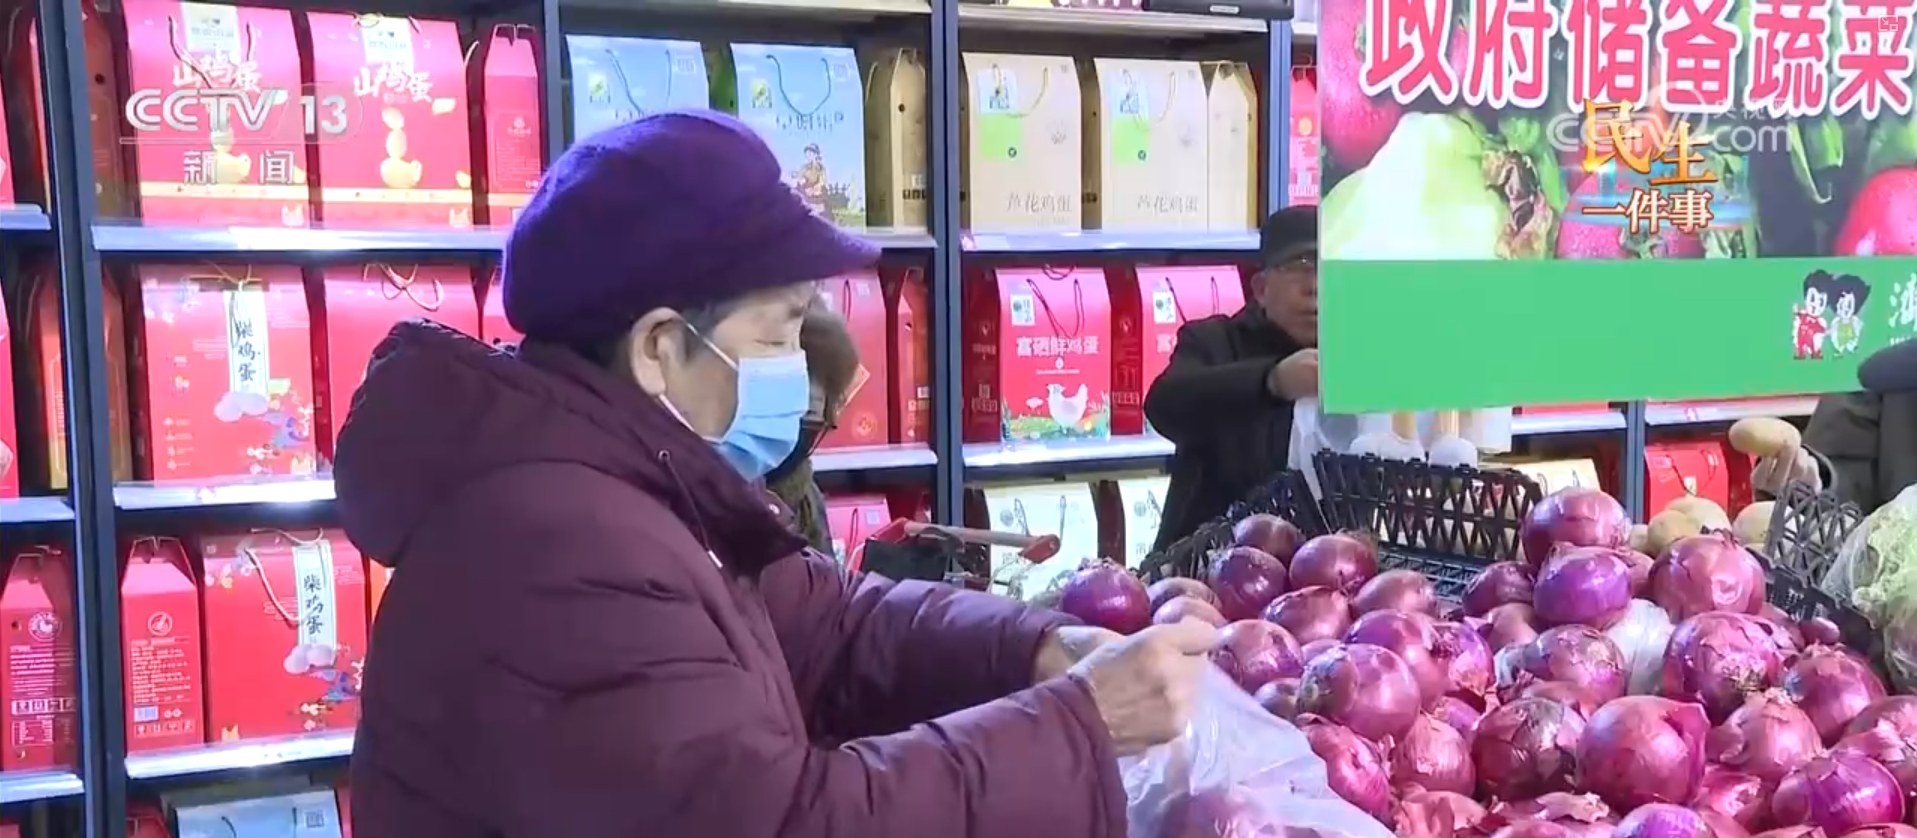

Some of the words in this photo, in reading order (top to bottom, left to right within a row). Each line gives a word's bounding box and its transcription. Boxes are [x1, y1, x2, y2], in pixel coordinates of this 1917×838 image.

[353, 60, 435, 103] 山鸡蛋
[1363, 0, 1910, 115] 政府储备蔬菜
[1016, 335, 1099, 357] 富硒鲜鸡蛋
[303, 573, 325, 636] 柴鸡蛋
